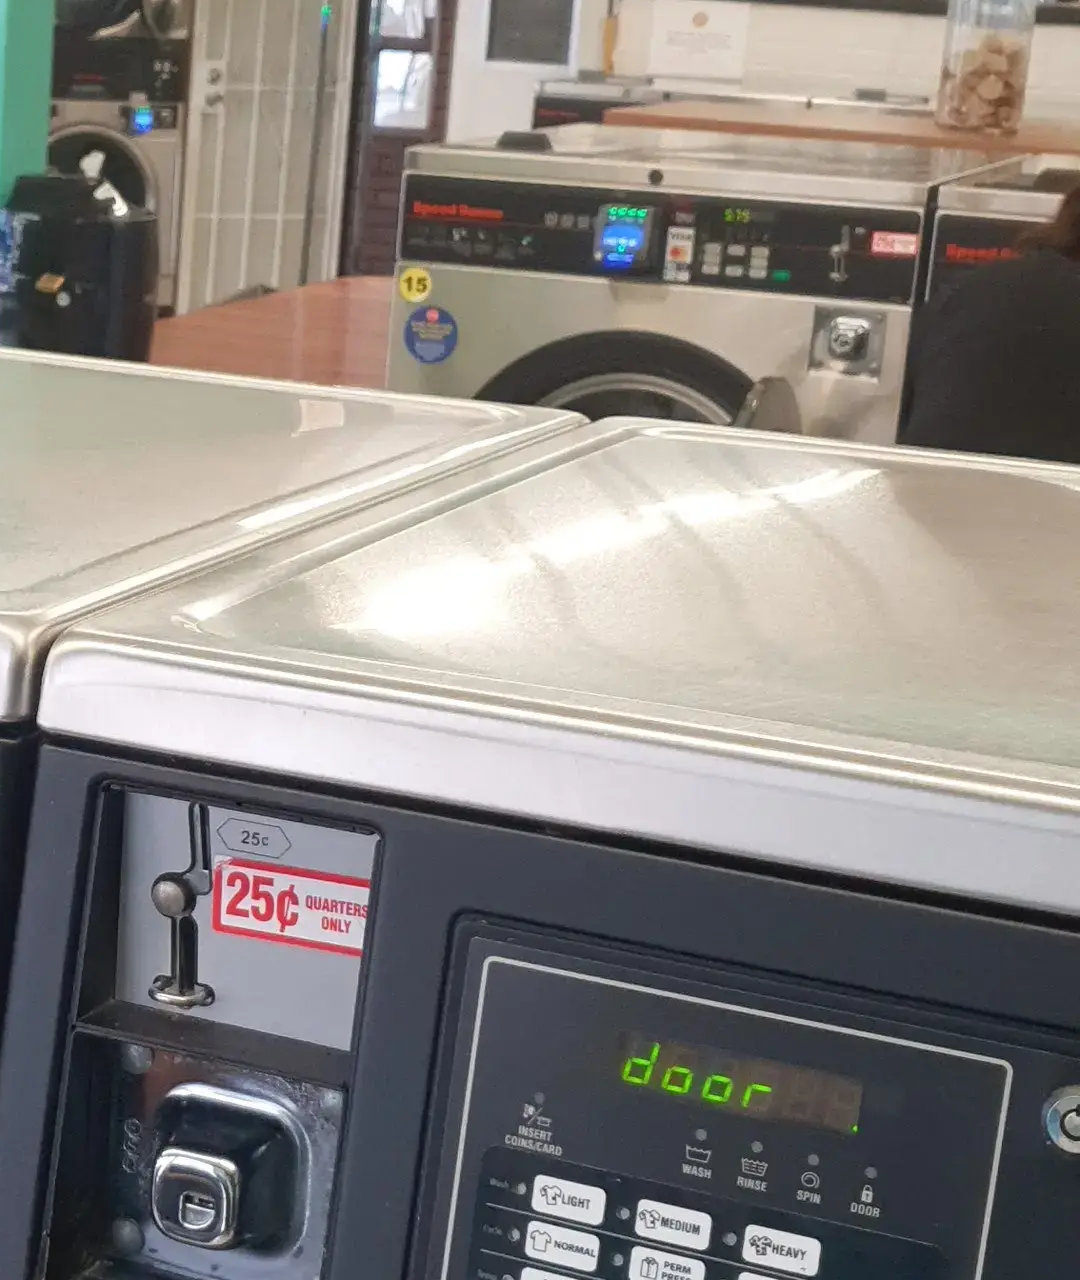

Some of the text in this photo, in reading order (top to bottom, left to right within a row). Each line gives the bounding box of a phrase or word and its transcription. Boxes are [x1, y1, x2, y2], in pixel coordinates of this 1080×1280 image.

[403, 276, 428, 293] 15
[226, 871, 369, 933] 25¢ QUARTERS
[321, 916, 351, 934] ONLY
[621, 1043, 772, 1108] door
[518, 1125, 552, 1141] INSERT
[505, 1134, 562, 1156] COINS/CARD
[682, 1163, 880, 1217] WASH RINSE SPIN DOOR
[560, 1191, 590, 1209] LIGHT
[661, 1217, 700, 1235] MEDIUM
[554, 1240, 596, 1258] NORMAL
[770, 1240, 807, 1260] HEAVY
[664, 1261, 691, 1274] PERM
